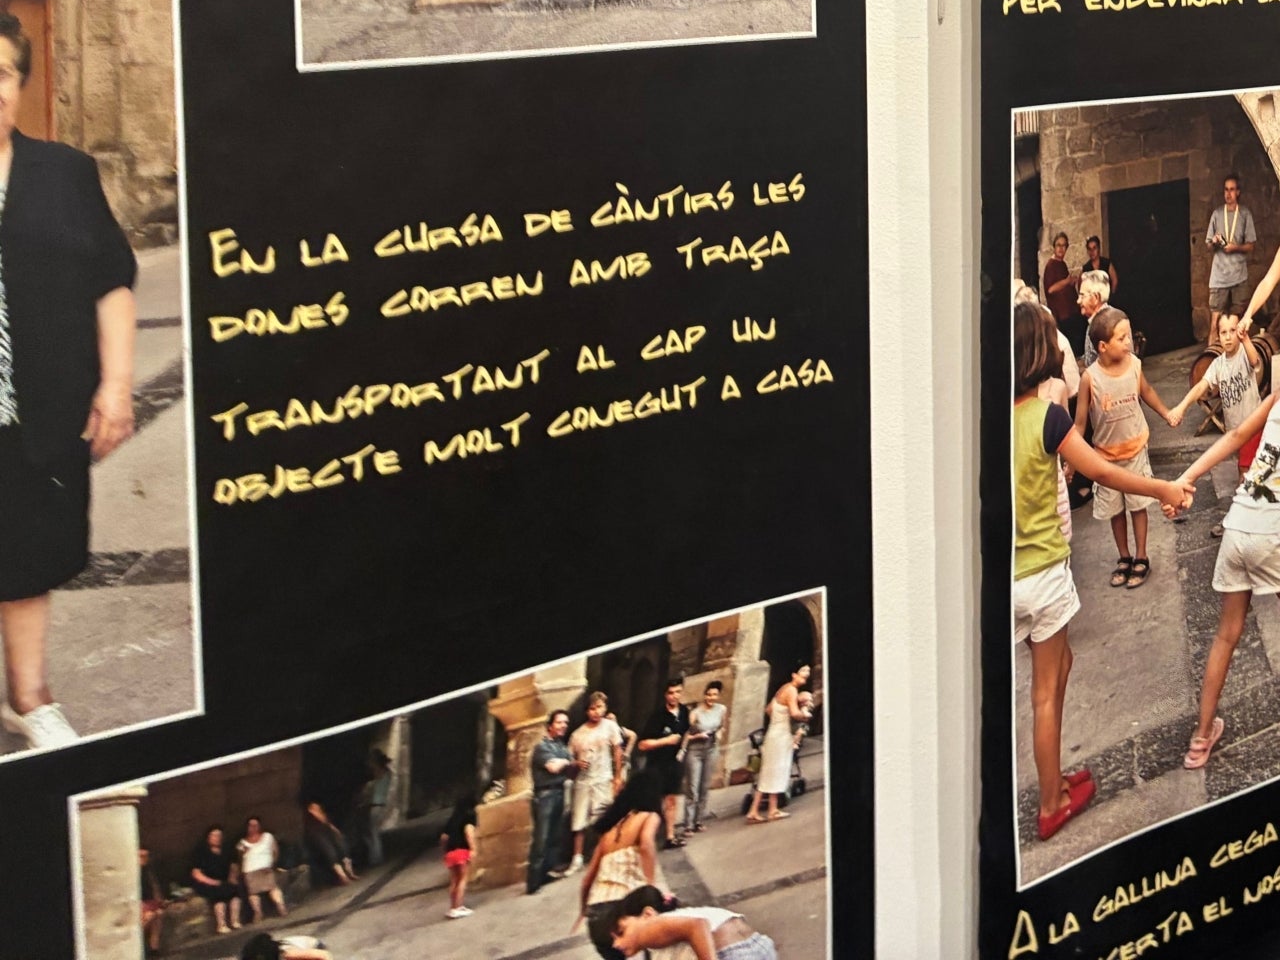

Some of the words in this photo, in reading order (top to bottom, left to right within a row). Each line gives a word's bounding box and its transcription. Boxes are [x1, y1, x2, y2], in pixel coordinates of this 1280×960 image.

[208, 227, 276, 278] EN
[299, 233, 349, 267] LA
[374, 212, 504, 258] CURSA
[523, 209, 574, 237] DE
[590, 180, 735, 228] CÀNTIRS
[753, 172, 806, 206] LES
[207, 291, 350, 343] DONES
[380, 270, 544, 318] CORREN
[569, 252, 652, 287] AMB
[676, 230, 791, 271] TRAÇA
[211, 348, 551, 441] TRANSPORTANT
[576, 344, 616, 374] AL
[640, 325, 707, 361] CAP
[732, 316, 776, 343] UN
[213, 443, 402, 506] OBJECTE
[424, 411, 531, 465] MOLT
[546, 375, 707, 438] CONEGUT
[720, 374, 742, 401] A
[756, 358, 834, 394] CASA
[1008, 909, 1039, 960] A
[1048, 911, 1081, 945] LA
[1091, 856, 1198, 923] GALLINA
[1209, 822, 1279, 869] CEGA
[1202, 896, 1233, 923] EL
